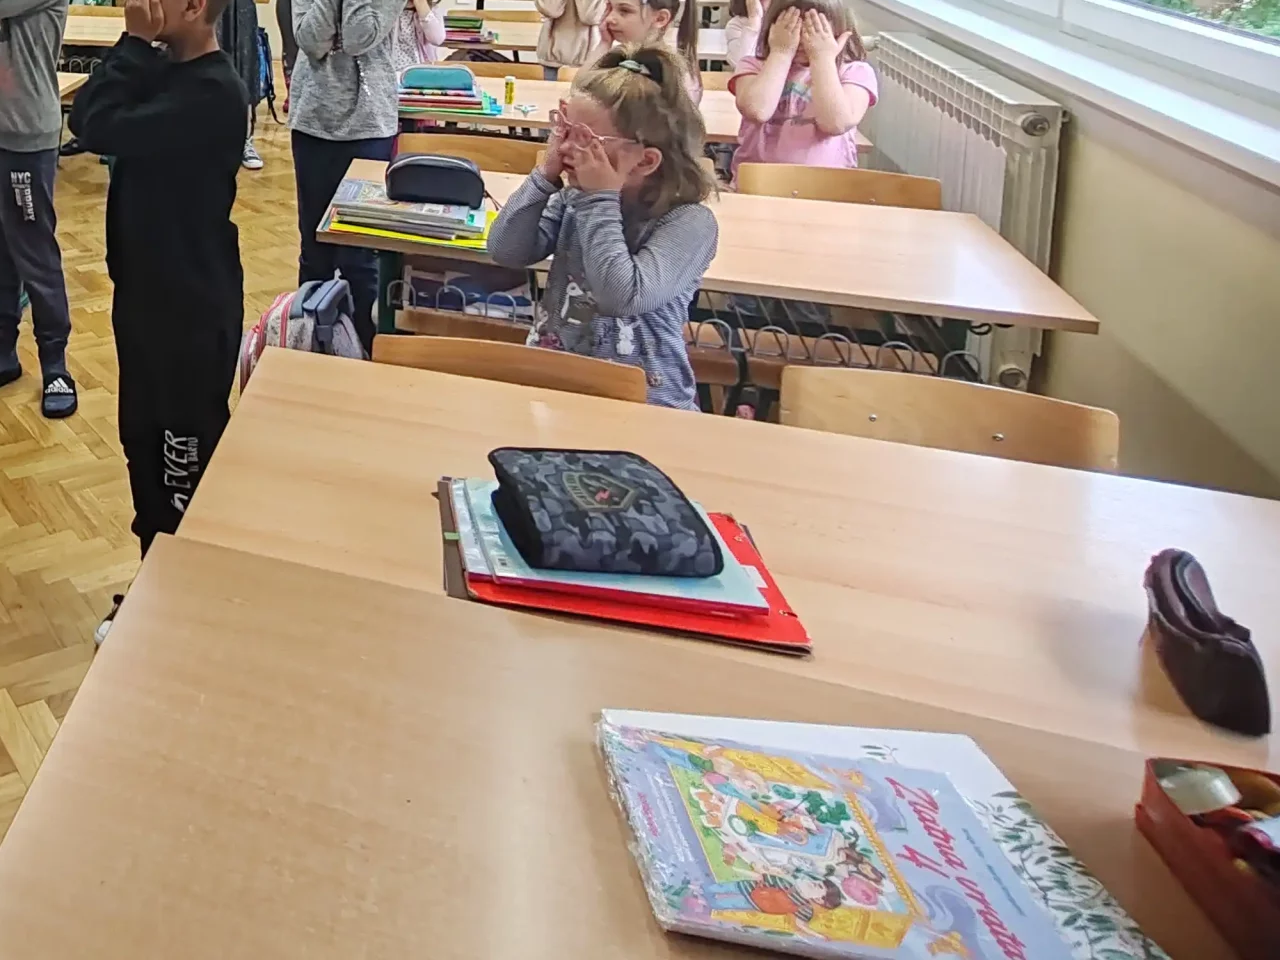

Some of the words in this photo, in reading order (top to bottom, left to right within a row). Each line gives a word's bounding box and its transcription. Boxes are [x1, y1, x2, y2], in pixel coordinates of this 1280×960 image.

[10, 171, 31, 184] NYC
[164, 429, 191, 513] NEVER
[884, 776, 968, 871] Zlatna
[895, 844, 952, 880] 4
